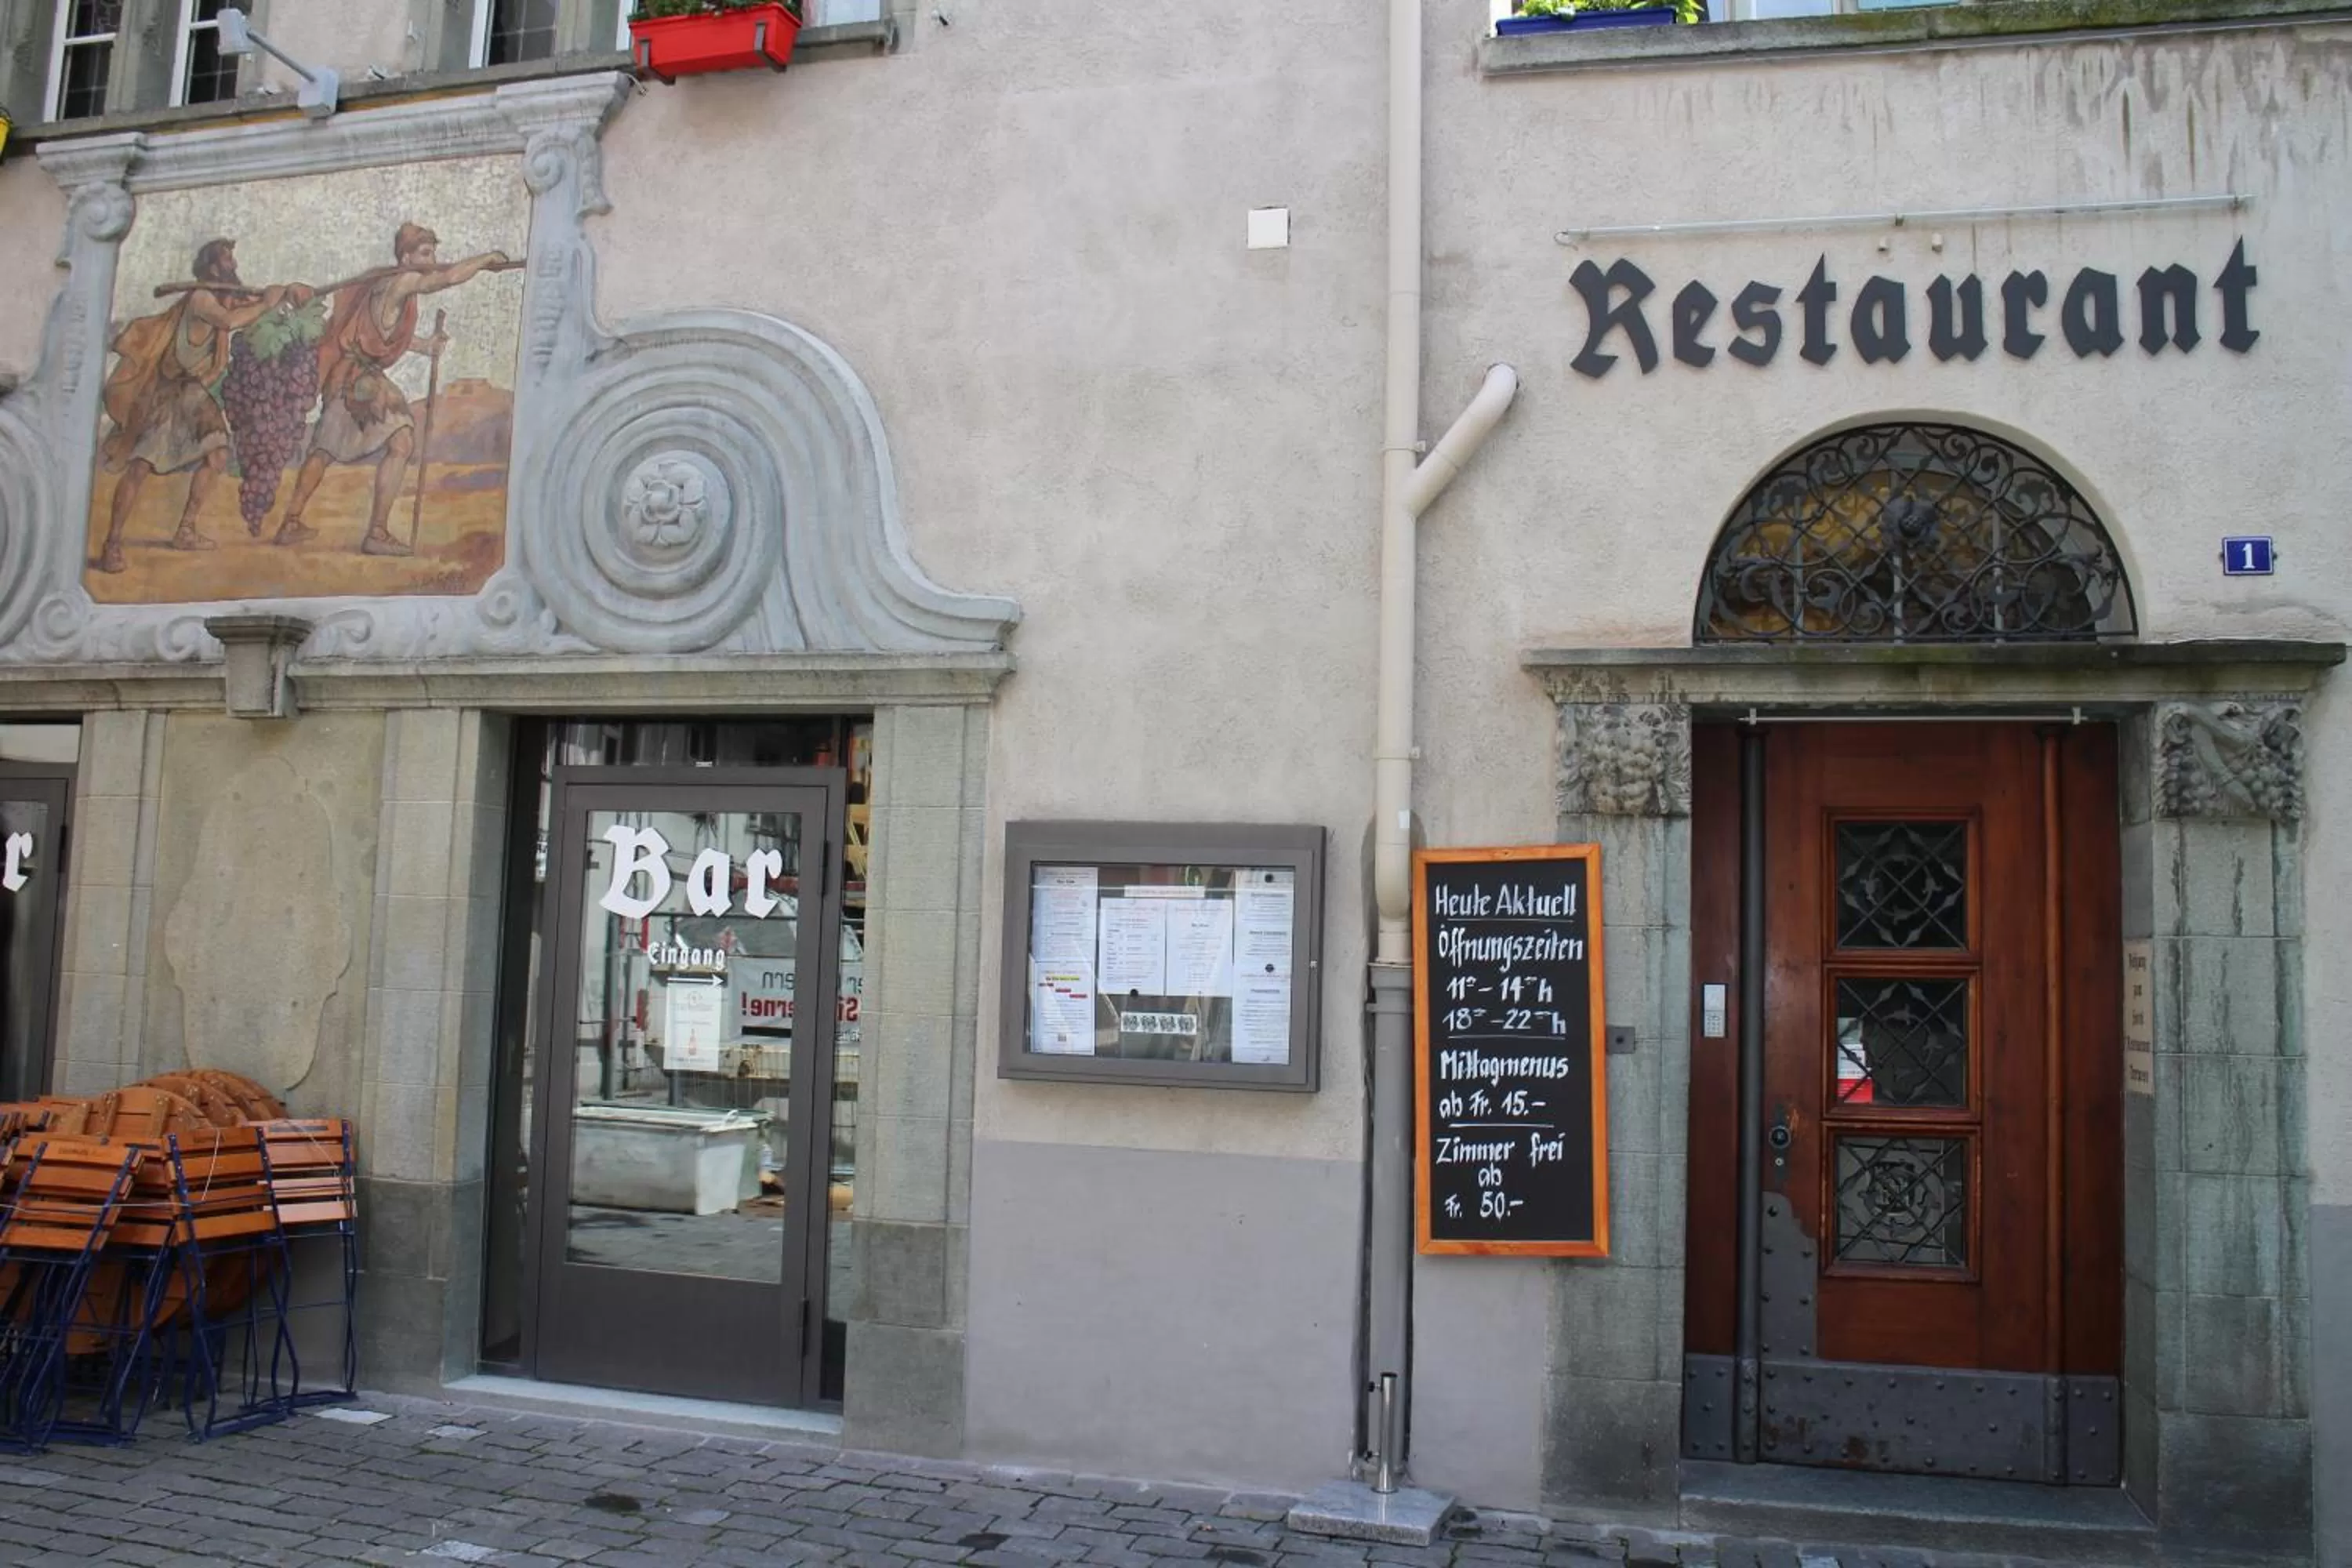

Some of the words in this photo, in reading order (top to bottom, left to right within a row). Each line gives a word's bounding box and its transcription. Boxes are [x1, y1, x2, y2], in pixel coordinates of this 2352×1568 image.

[1569, 234, 2261, 380] Restaurant
[2242, 542, 2256, 570] 1
[598, 823, 783, 920] Bar
[1435, 883, 1491, 916] Heute
[1494, 883, 1577, 916] Aktuell
[648, 941, 726, 972] Eingang
[1438, 924, 1584, 973] Öffnungszeiten
[1439, 1048, 1569, 1087] Mittagmenus
[1439, 1089, 1464, 1119] ab
[1468, 1088, 1493, 1117] Fr.
[1436, 1136, 1515, 1164] Zimmer
[1530, 1131, 1566, 1168] frei
[1477, 1161, 1503, 1188] ab
[1444, 1193, 1463, 1218] Fr.
